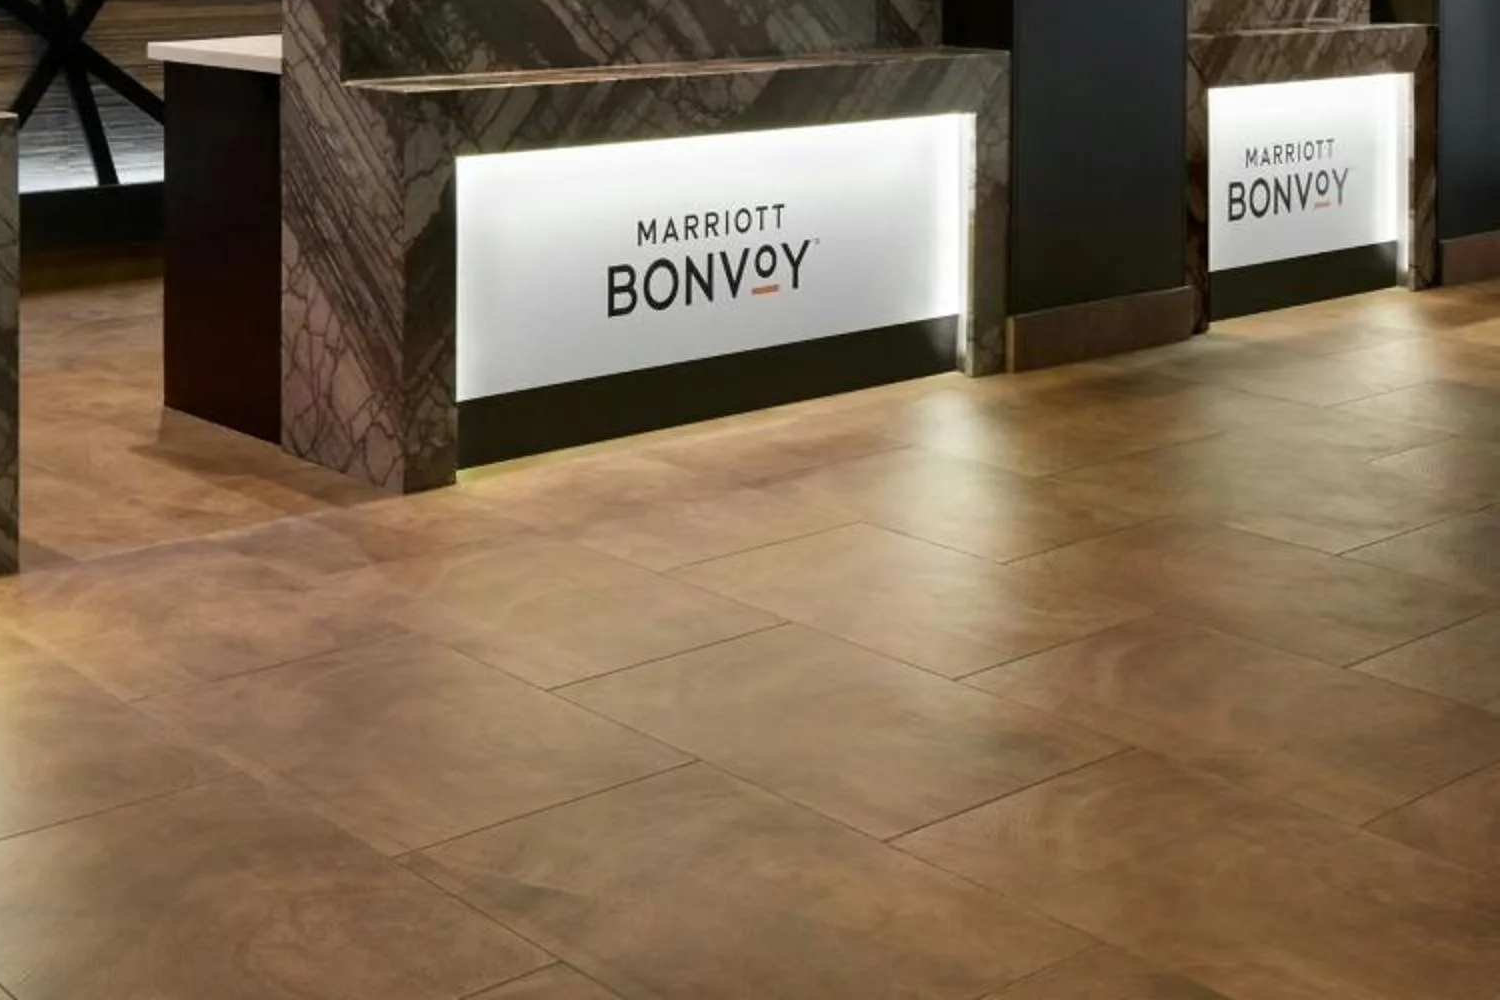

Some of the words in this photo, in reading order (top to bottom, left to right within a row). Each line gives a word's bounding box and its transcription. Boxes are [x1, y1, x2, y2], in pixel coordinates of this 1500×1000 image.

[1245, 138, 1335, 168] MARRIOTT
[1227, 167, 1349, 222] BONVOY
[637, 203, 785, 247] MARRIOTT
[607, 239, 811, 318] BONVOY
